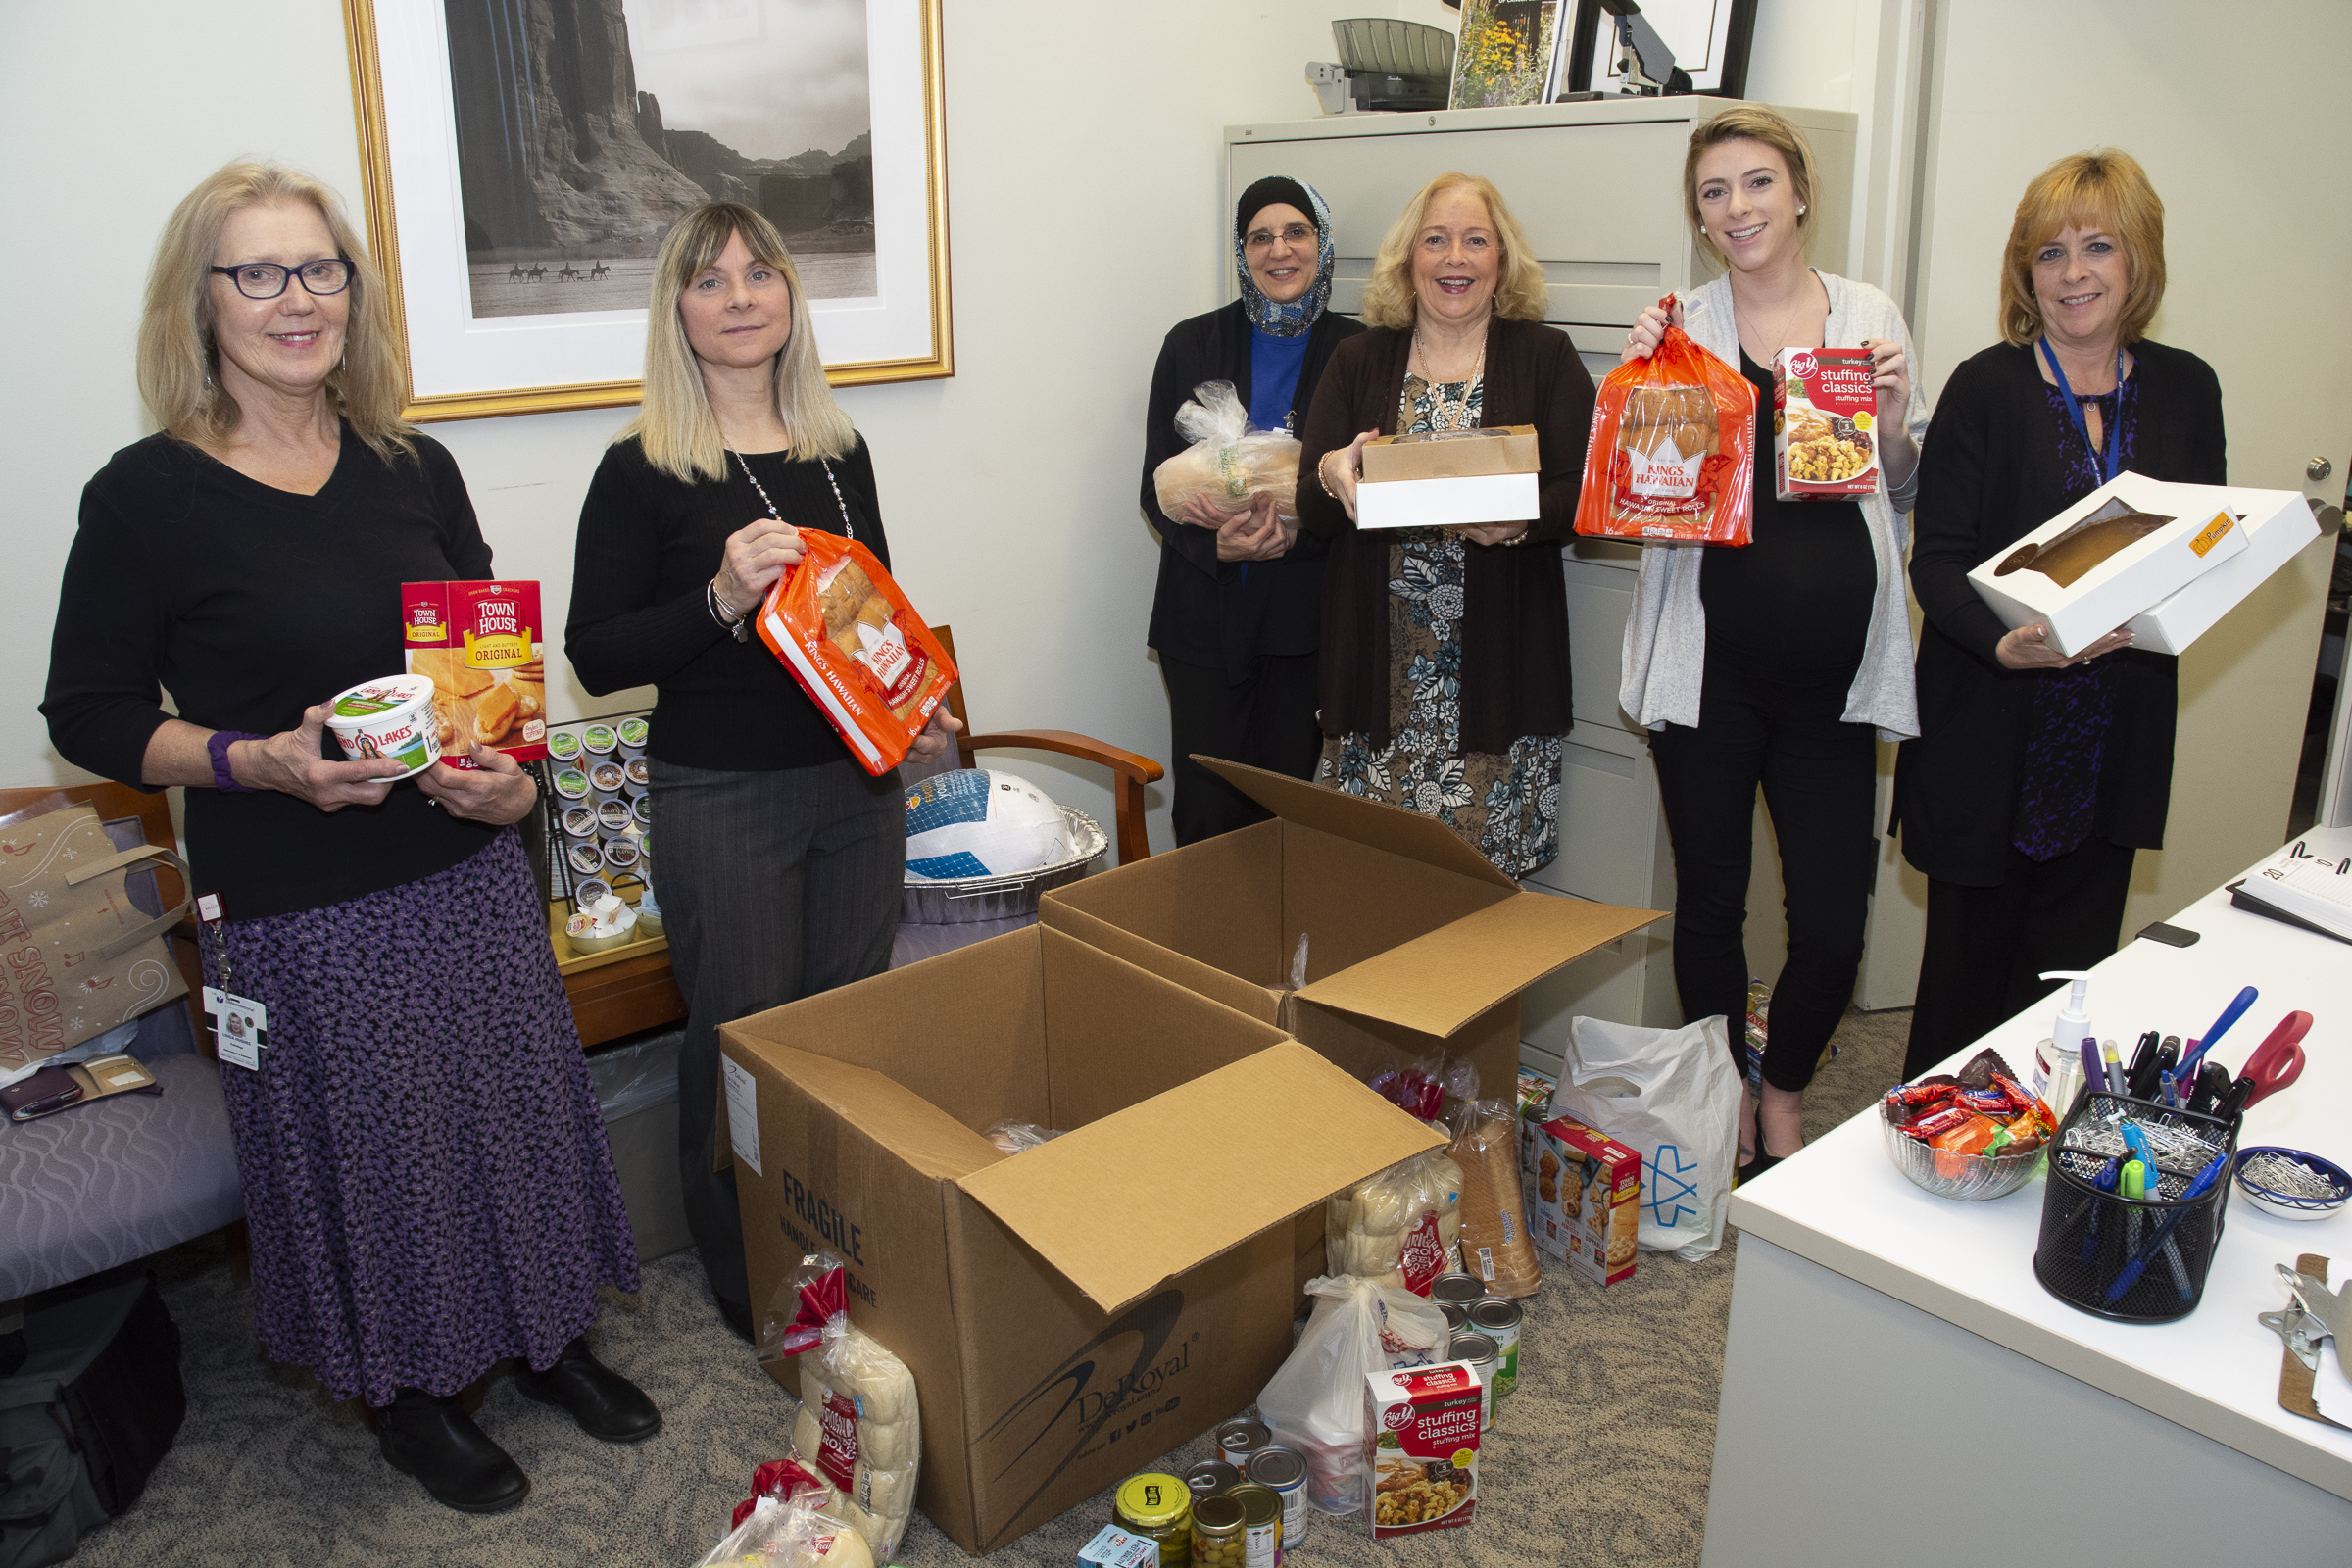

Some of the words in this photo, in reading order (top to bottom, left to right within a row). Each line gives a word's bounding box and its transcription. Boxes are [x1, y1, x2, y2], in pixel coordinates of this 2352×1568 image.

[1790, 360, 1805, 371] Big
[1842, 358, 1862, 367] turkey
[1821, 382, 1873, 394] classics
[1647, 464, 1685, 476] KING'S
[1635, 473, 1694, 488] HAWAIIAN
[1619, 497, 1655, 513] HAWAIIAN
[1682, 501, 1706, 512] ROLLS
[1605, 526, 1614, 535] 16
[2205, 517, 2232, 542] Pumpkin
[413, 609, 436, 617] TOWN
[477, 601, 515, 618] TOWN
[414, 616, 437, 625] HOUSE
[478, 617, 518, 635] HOUSE
[475, 648, 523, 662] ORIGINAL
[870, 639, 894, 665] KING'S
[876, 643, 906, 679] HAWAIIAN
[804, 640, 829, 671] KING'S
[825, 670, 864, 717] HAWAIIAN
[897, 671, 912, 690] ORIGINAL
[906, 674, 919, 693] SWEET
[915, 657, 925, 677] ROLLS
[377, 727, 413, 746] LAKES
[907, 726, 917, 737] 16
[2262, 868, 2285, 880] 20
[6, 945, 66, 1052] SNOW
[782, 1168, 865, 1268] FRAGILE
[779, 1214, 816, 1256] HANDLE
[848, 1271, 878, 1309] CARE
[1076, 1341, 1190, 1425] DeRoyal
[1422, 1372, 1455, 1383] stuffing
[1425, 1377, 1457, 1387] classics
[1077, 1388, 1156, 1434] www.deroyal.com
[1444, 1398, 1467, 1408] turkey
[1382, 1411, 1401, 1427] Big
[1417, 1409, 1477, 1428] stuffing
[1417, 1421, 1477, 1441] classics
[1432, 1435, 1460, 1446] stuffing
[1460, 1432, 1476, 1443] mix
